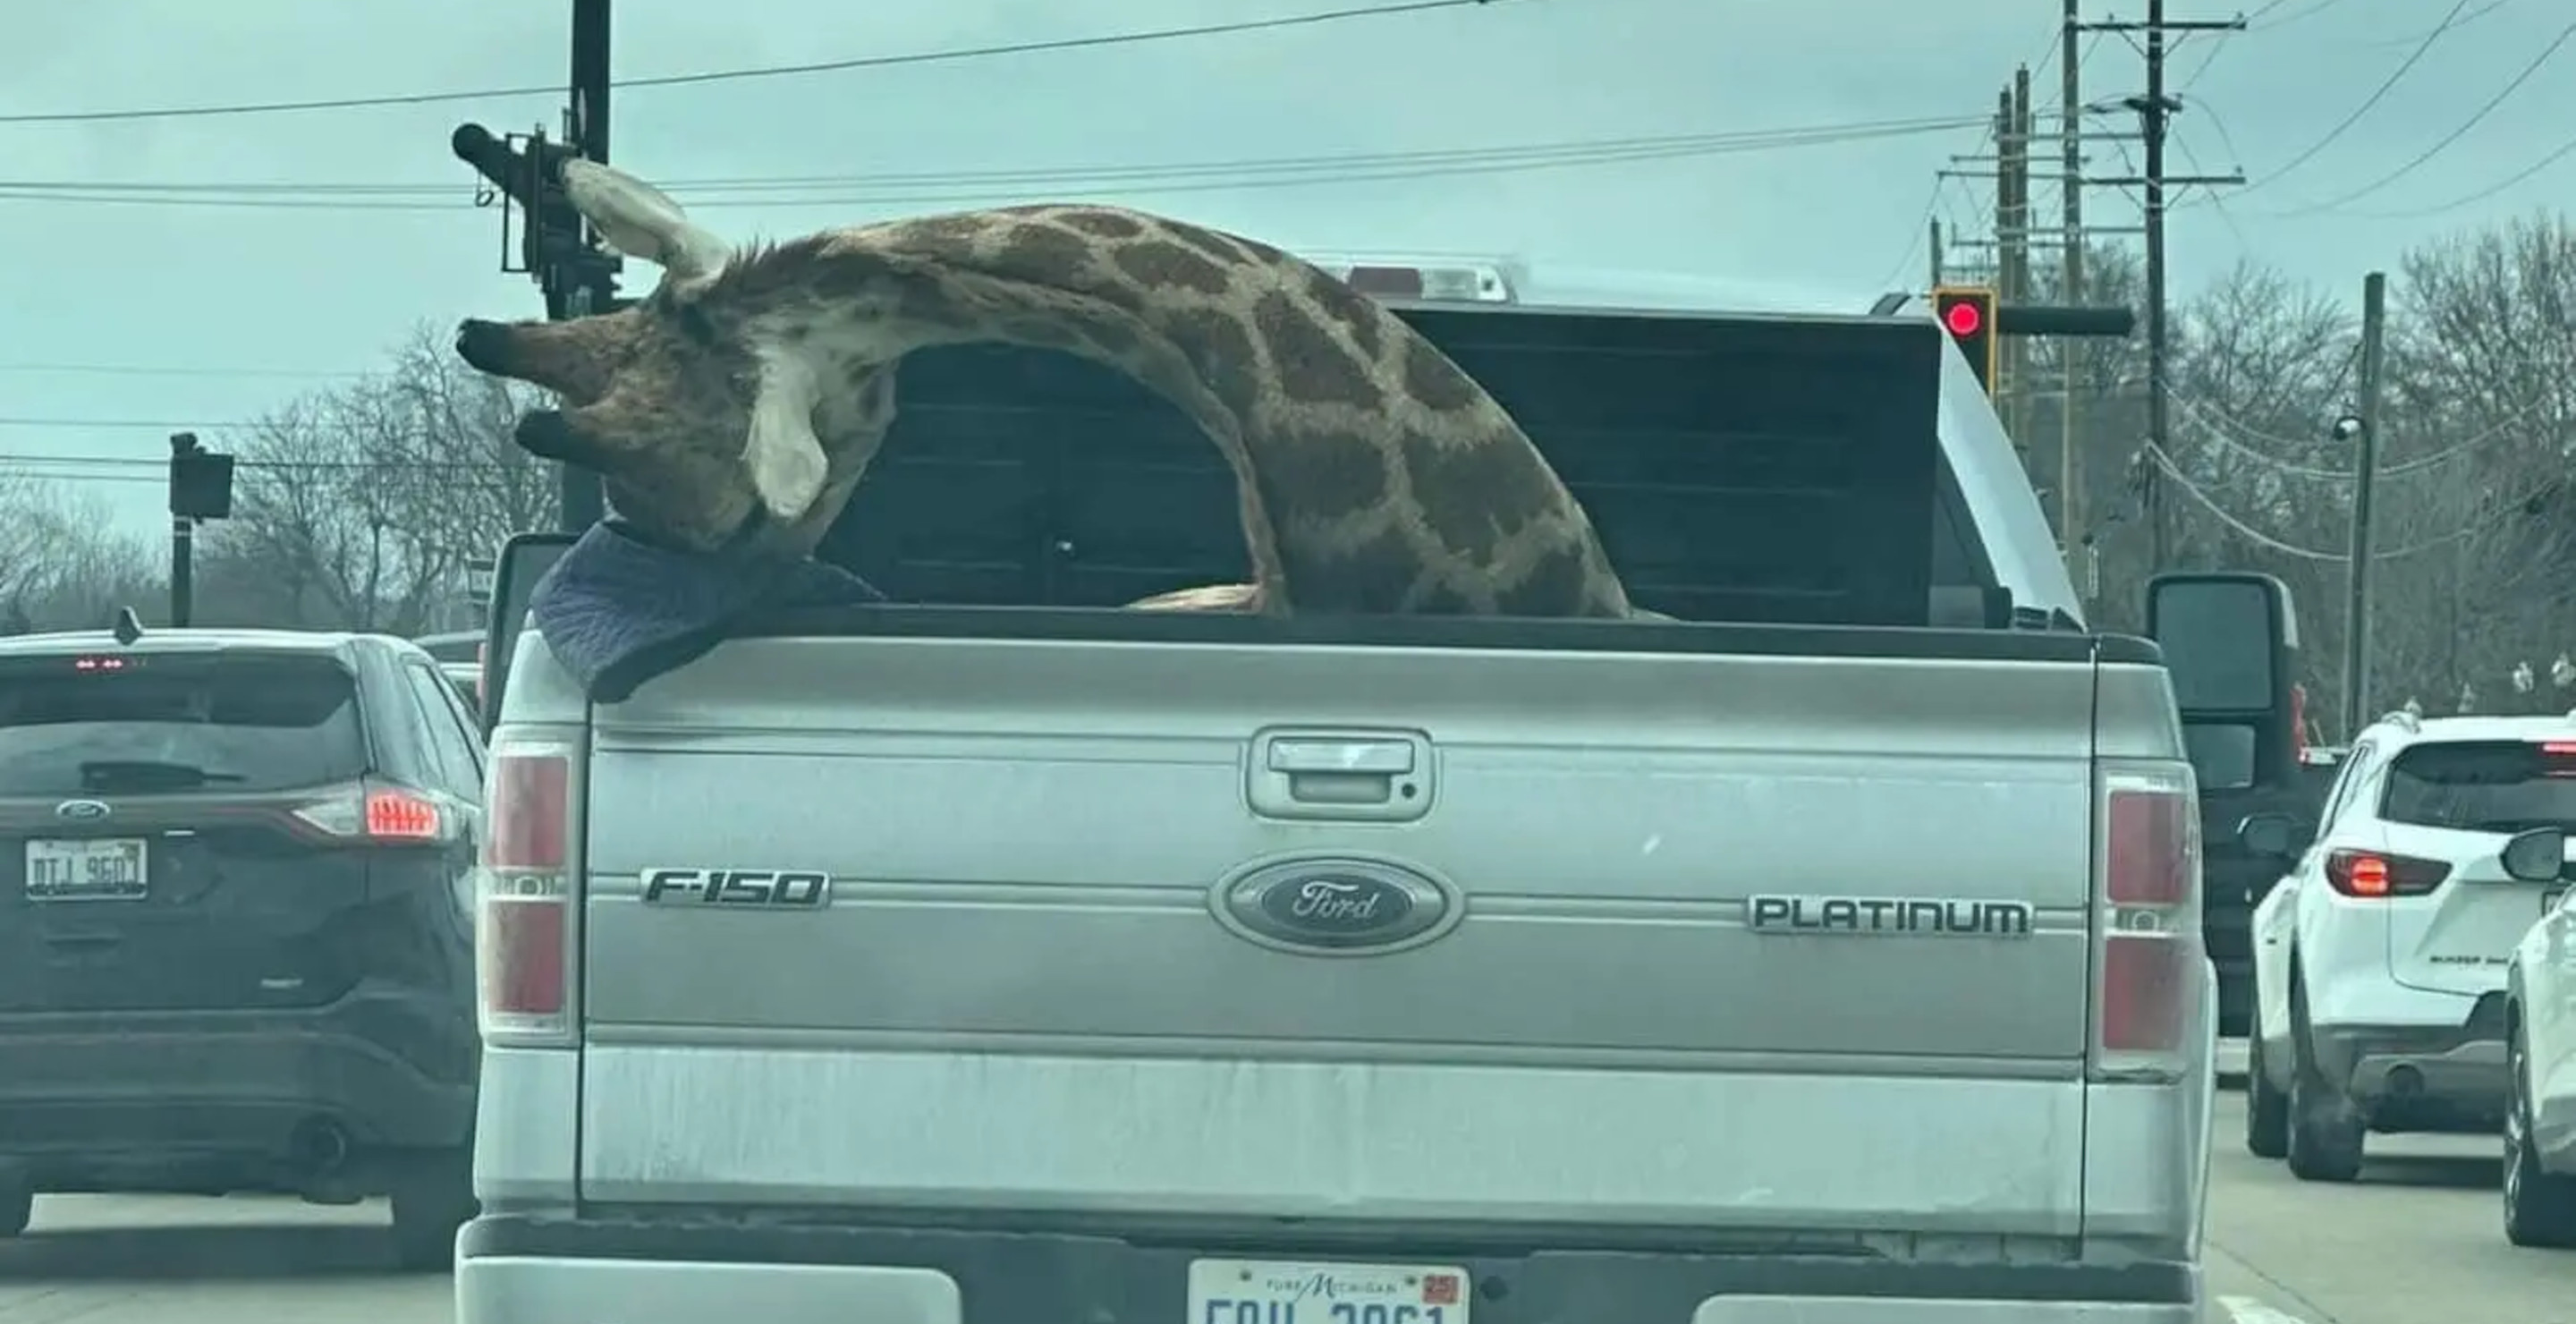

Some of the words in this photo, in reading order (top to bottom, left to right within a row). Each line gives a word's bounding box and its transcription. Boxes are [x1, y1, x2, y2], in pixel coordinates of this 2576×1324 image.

[646, 871, 826, 904] F-150
[1292, 880, 1380, 920] Ford
[1754, 897, 2028, 933] PLATINUM
